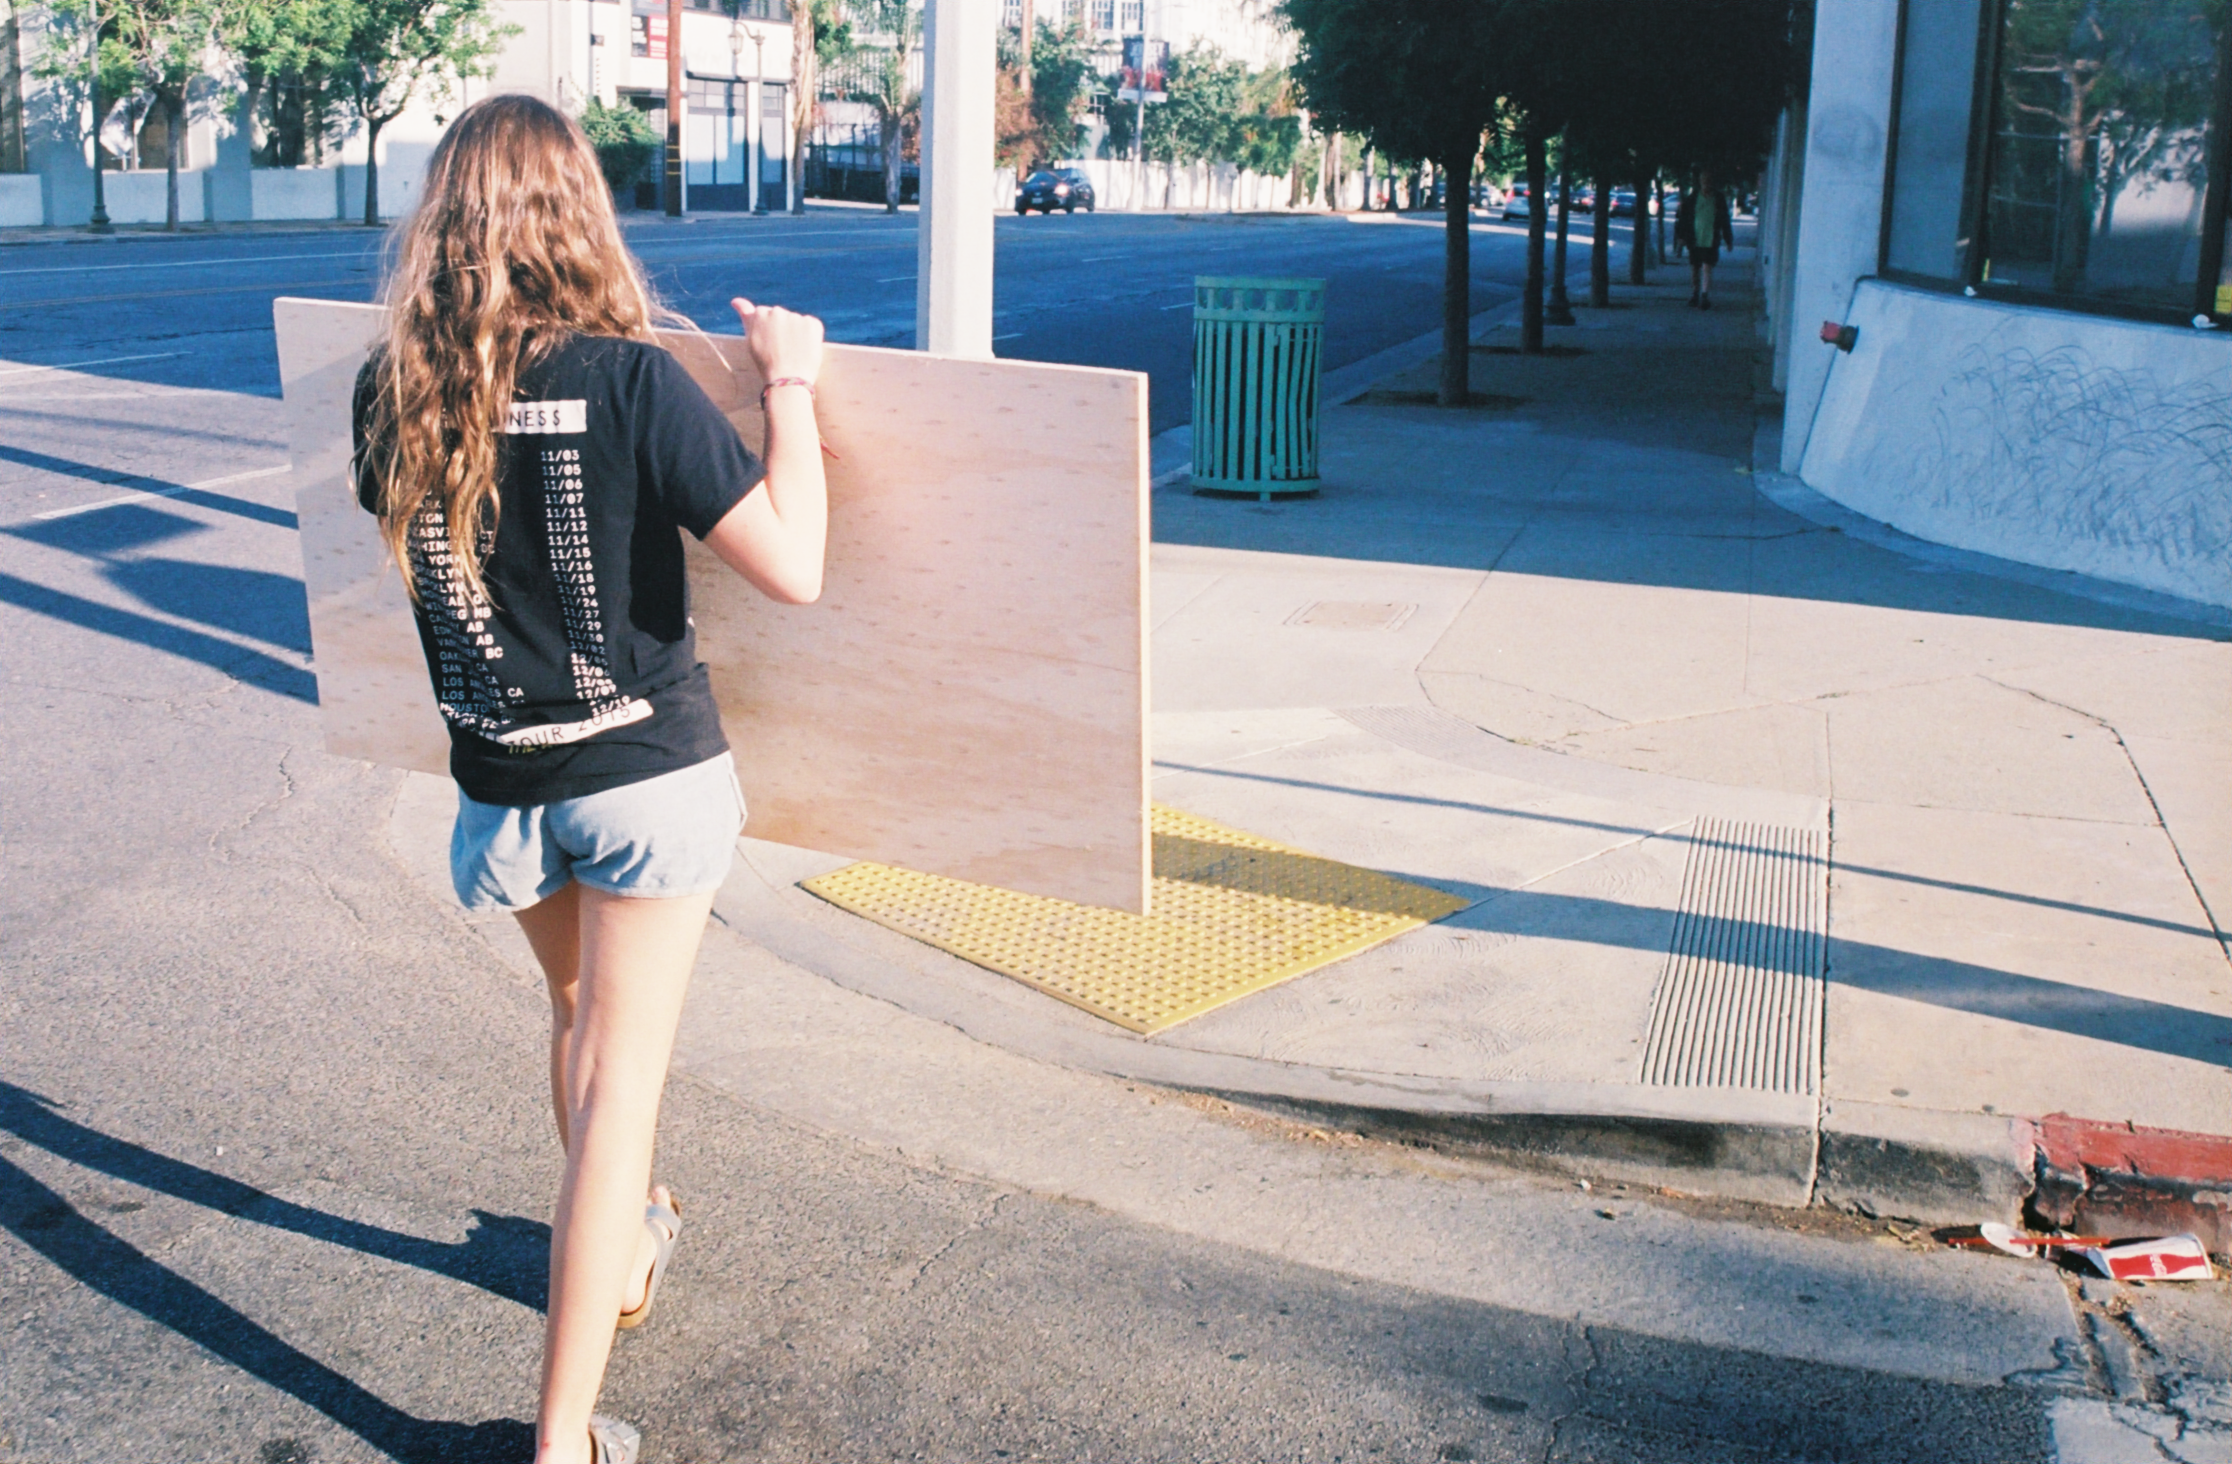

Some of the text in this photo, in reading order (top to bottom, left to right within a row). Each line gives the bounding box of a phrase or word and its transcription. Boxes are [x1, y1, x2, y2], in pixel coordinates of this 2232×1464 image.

[509, 409, 560, 427] NESS
[541, 449, 580, 462] 11/03
[542, 464, 582, 476] 11/05
[544, 478, 583, 491] 11/06
[545, 492, 584, 505] 11/07
[546, 507, 586, 519] 11/11
[547, 520, 588, 532] 11/12
[548, 534, 589, 546] 11/14
[550, 547, 591, 559] 11/15
[551, 560, 593, 572] 11/16
[554, 573, 594, 584] 11/18
[558, 585, 596, 596] 11/19
[561, 596, 598, 608] 11/24
[563, 607, 600, 619] 11/27
[466, 620, 485, 633] AB
[566, 618, 602, 631] 11/29
[475, 633, 494, 646] AB
[568, 629, 604, 643] 11/30
[485, 646, 504, 660] BC
[441, 663, 462, 674] SAN
[443, 677, 464, 688] LOS
[507, 686, 525, 698] CA
[441, 690, 465, 701] LOS
